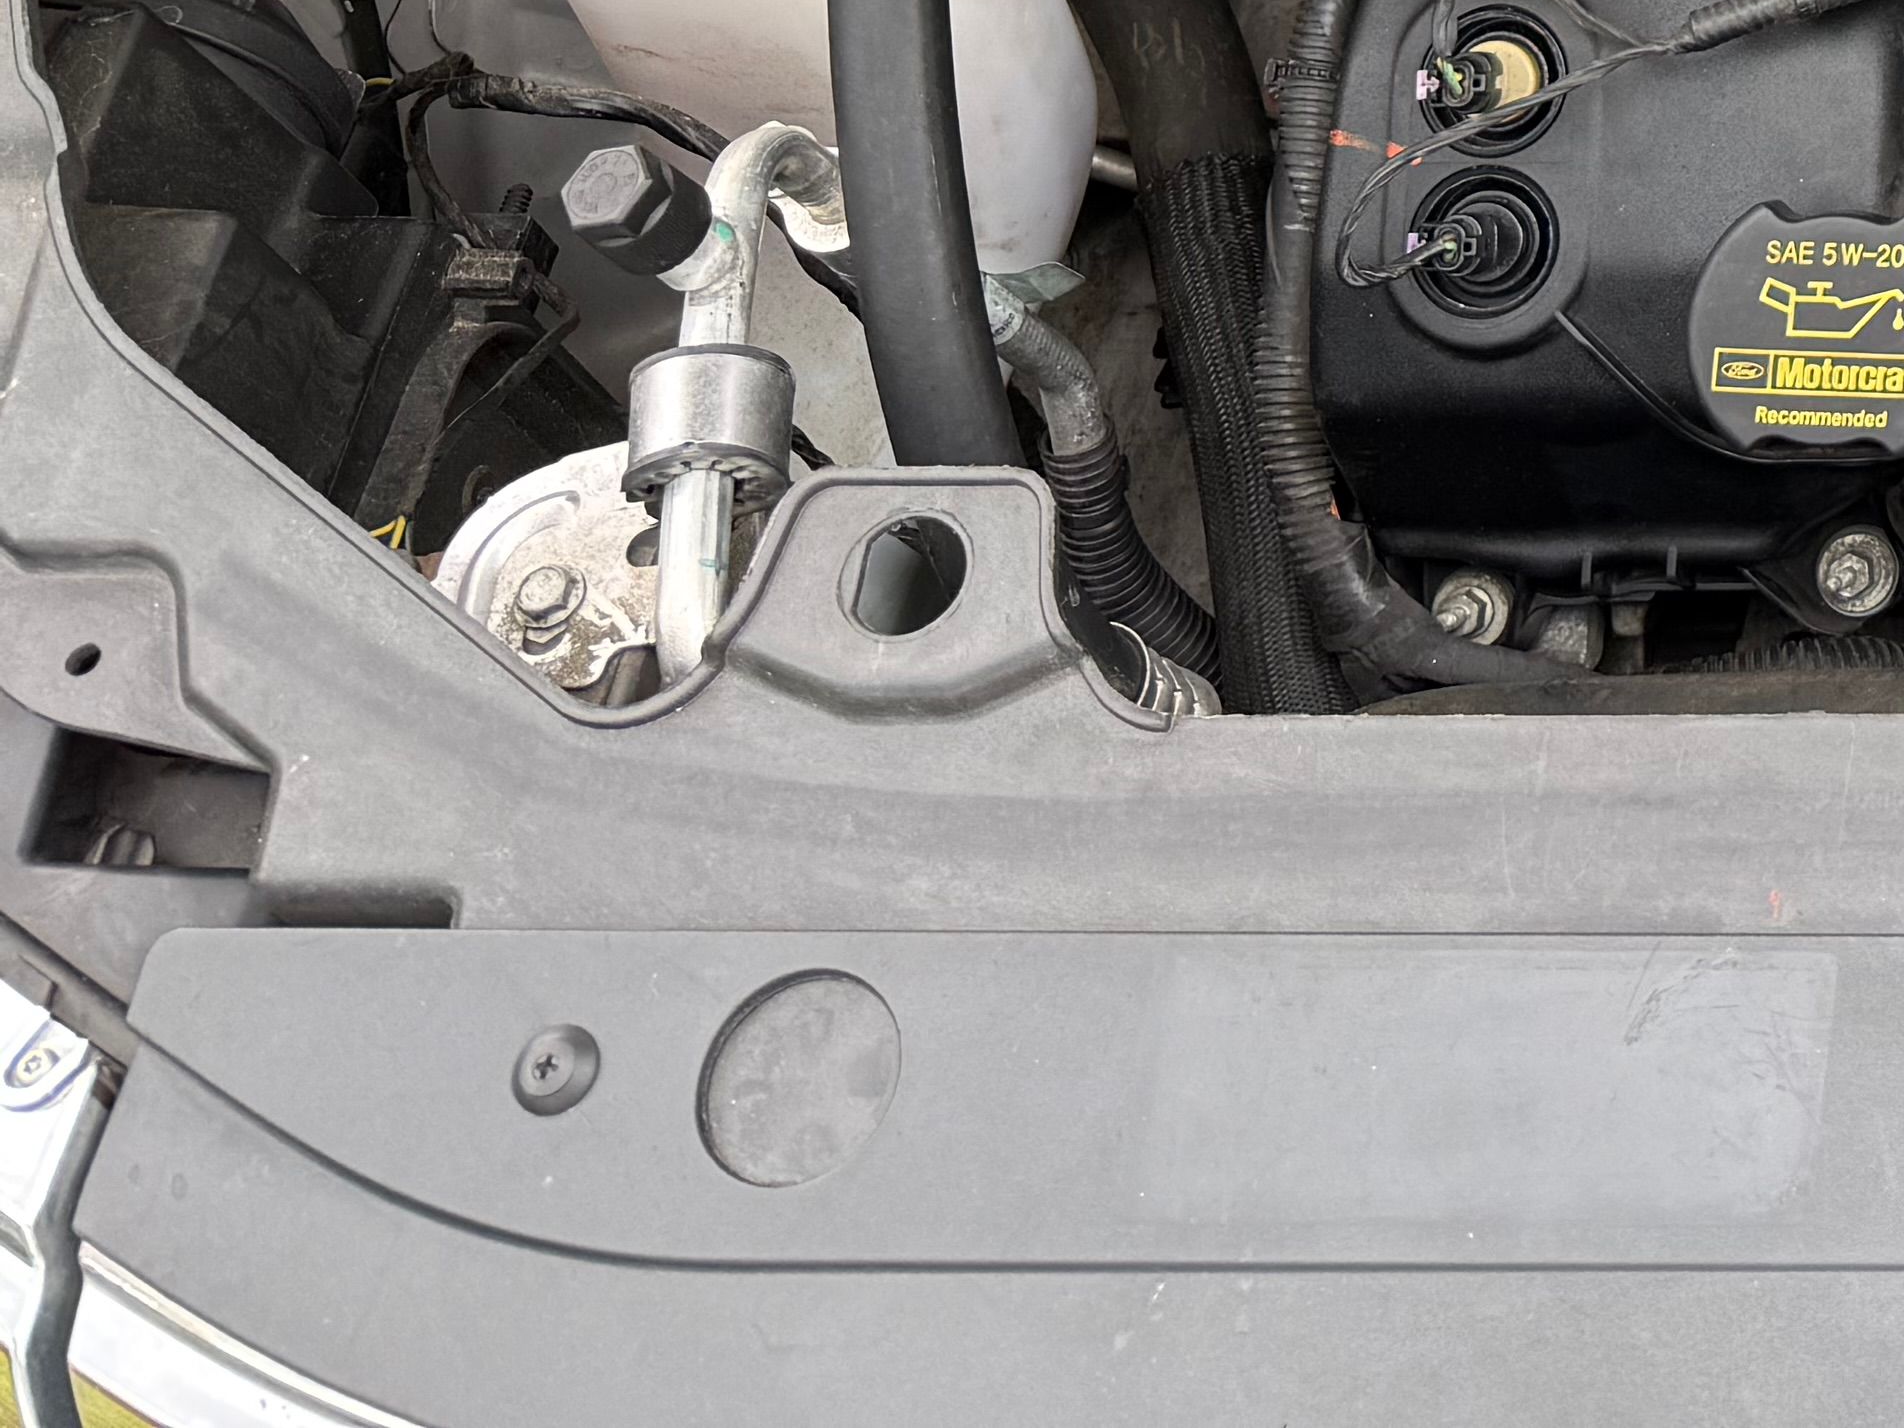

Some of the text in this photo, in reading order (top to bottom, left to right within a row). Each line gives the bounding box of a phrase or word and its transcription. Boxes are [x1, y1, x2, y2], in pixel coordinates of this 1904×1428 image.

[1766, 239, 1815, 265] SAE
[1722, 361, 1764, 379] Ford
[1755, 405, 1888, 428] Recommended
